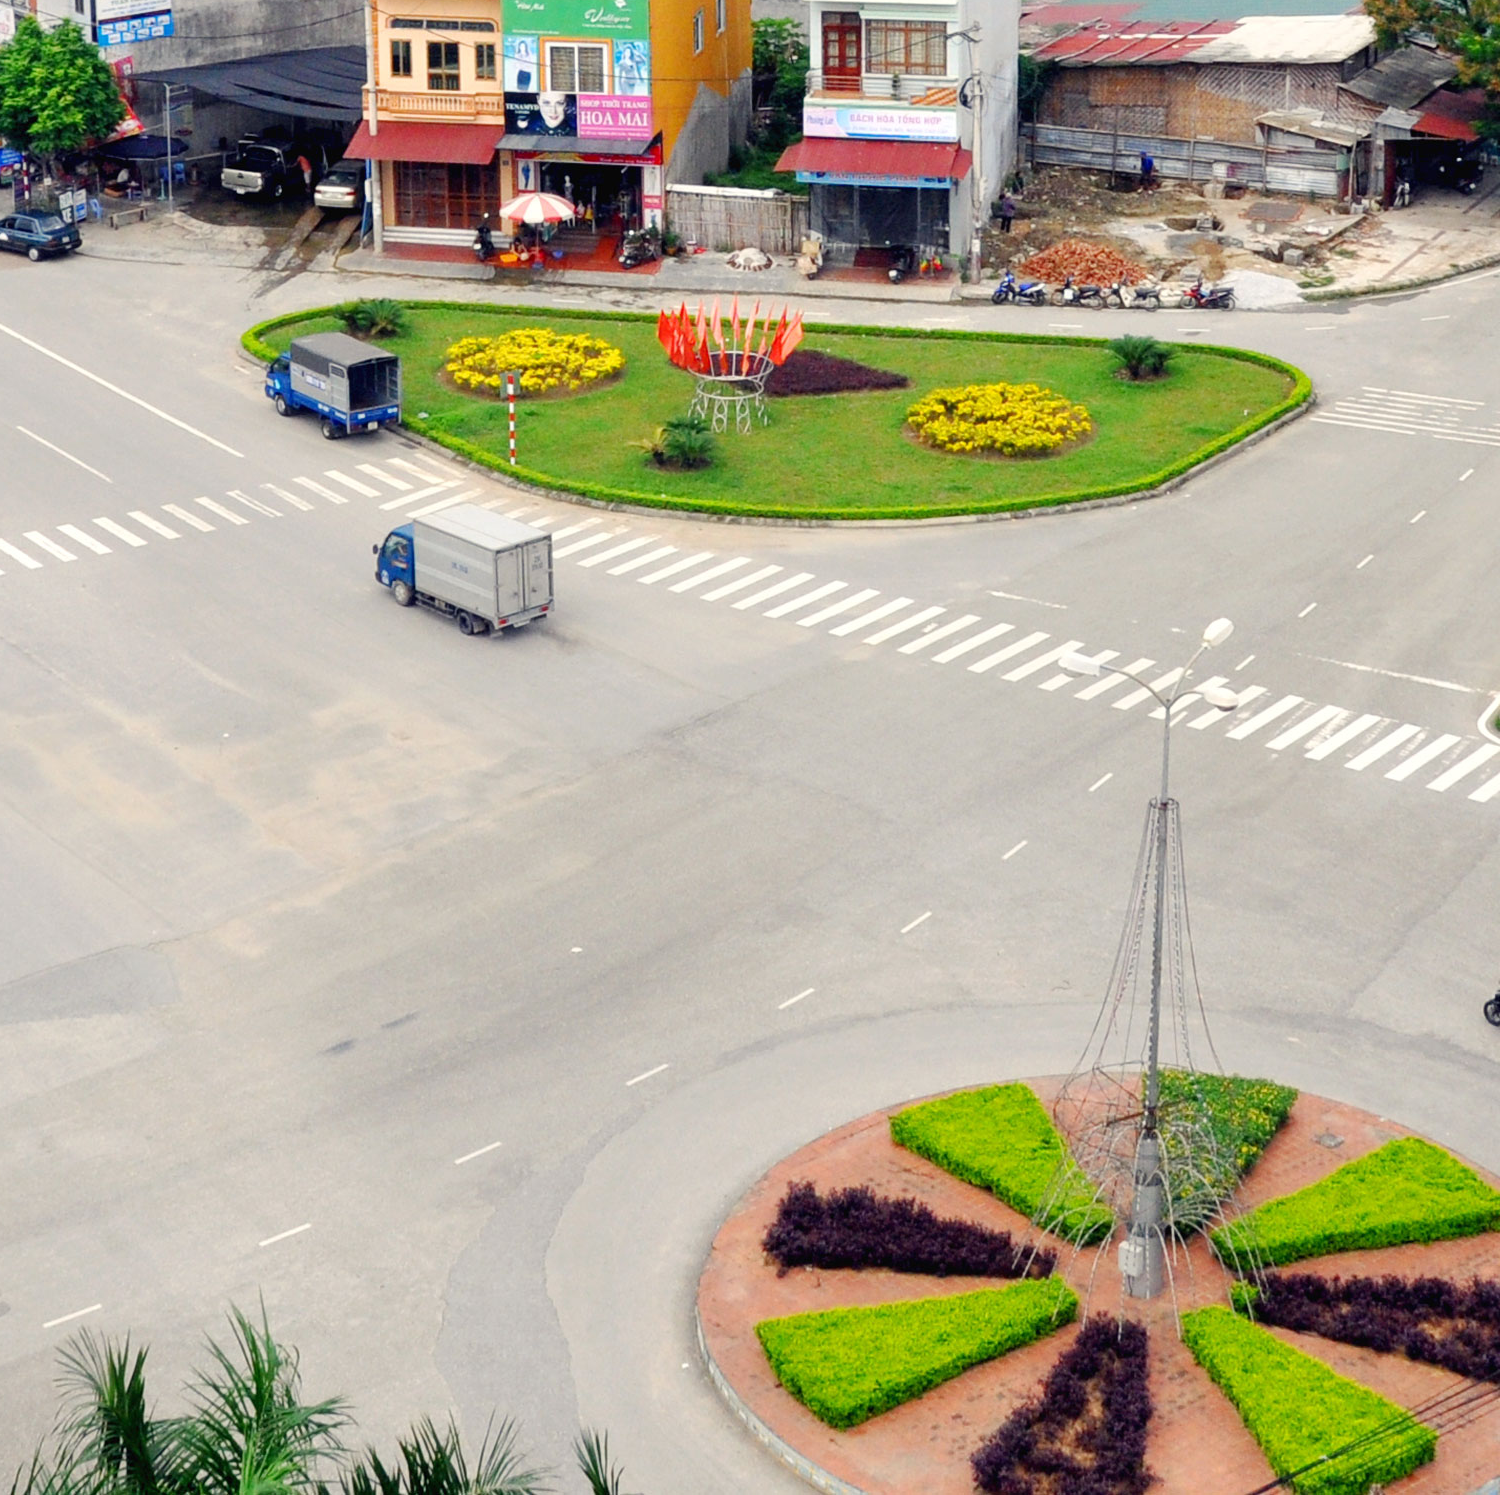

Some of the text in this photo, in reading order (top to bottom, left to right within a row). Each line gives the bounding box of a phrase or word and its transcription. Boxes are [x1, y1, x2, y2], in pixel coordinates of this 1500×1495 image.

[602, 99, 620, 108] THỜI
[622, 101, 648, 109] TRANG
[580, 111, 649, 127] HOA MAI
